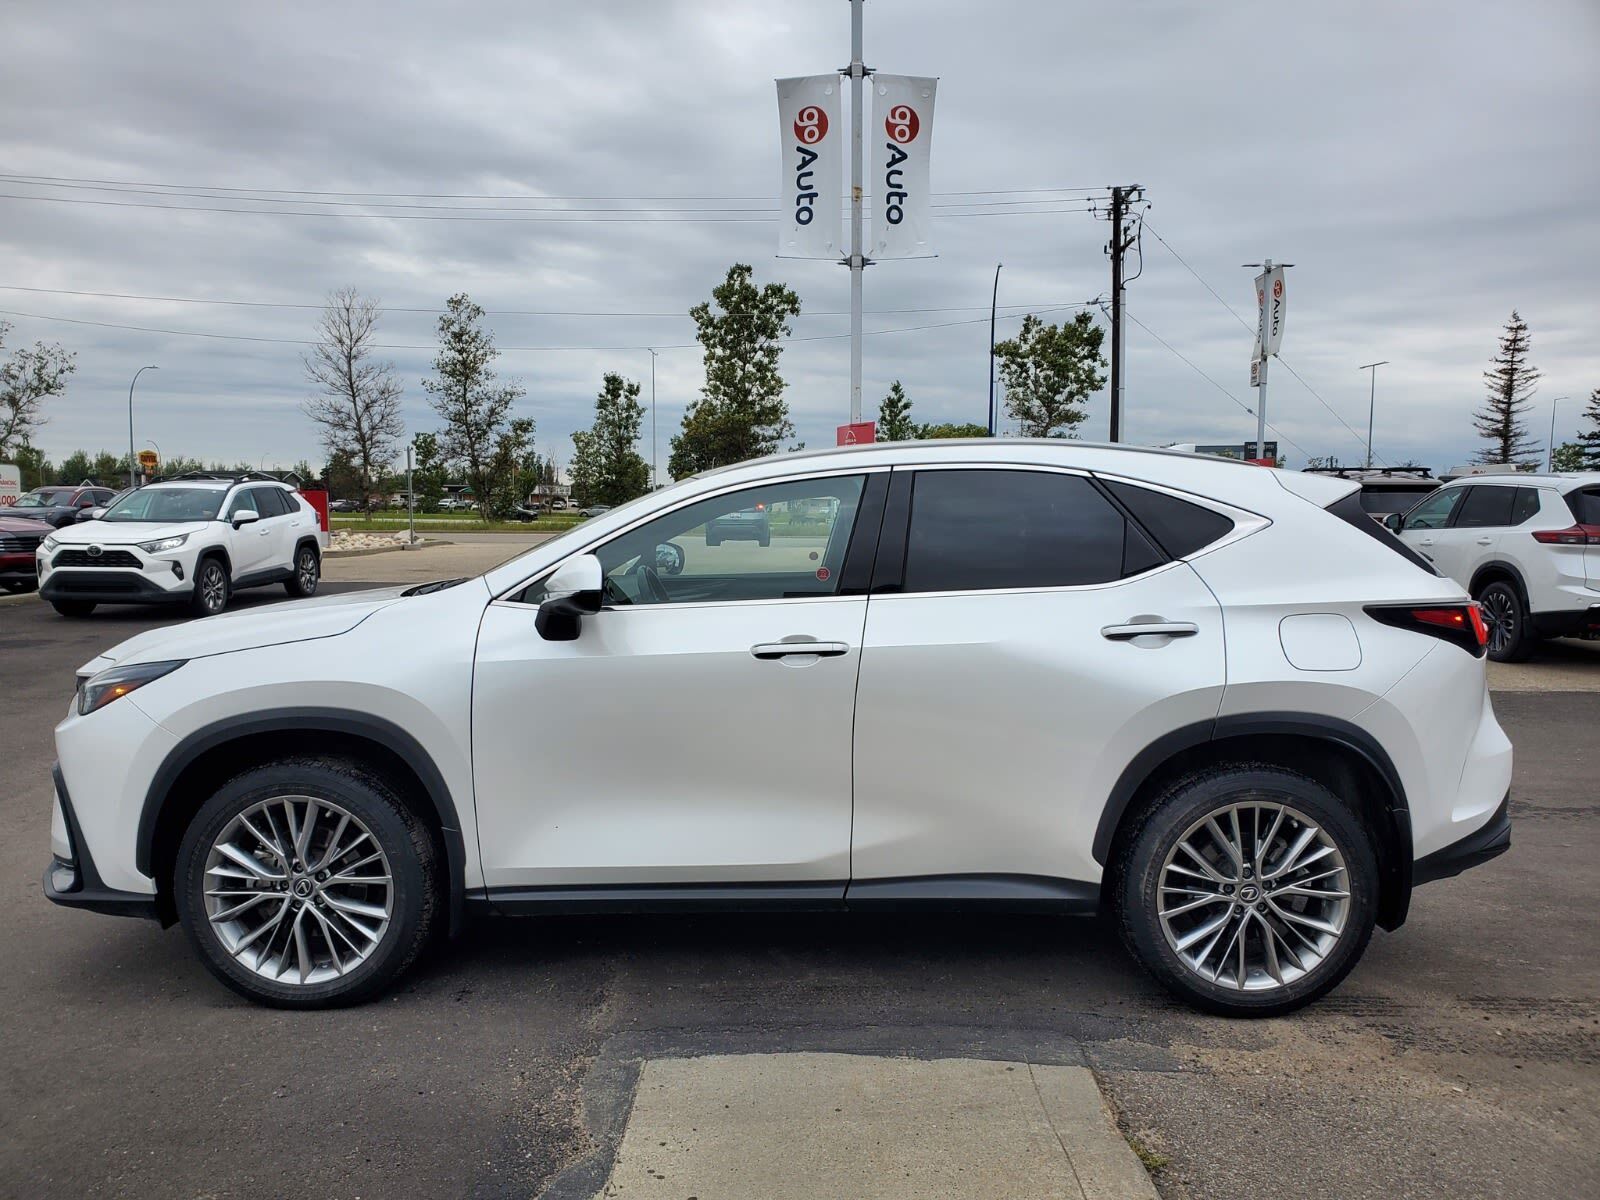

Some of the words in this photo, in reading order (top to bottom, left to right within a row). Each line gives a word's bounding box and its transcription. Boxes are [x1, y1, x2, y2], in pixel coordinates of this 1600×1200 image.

[795, 107, 819, 143] go
[887, 106, 911, 142] go
[796, 146, 819, 225] Auto
[886, 143, 908, 225] Auto
[1272, 299, 1280, 337] Auto
